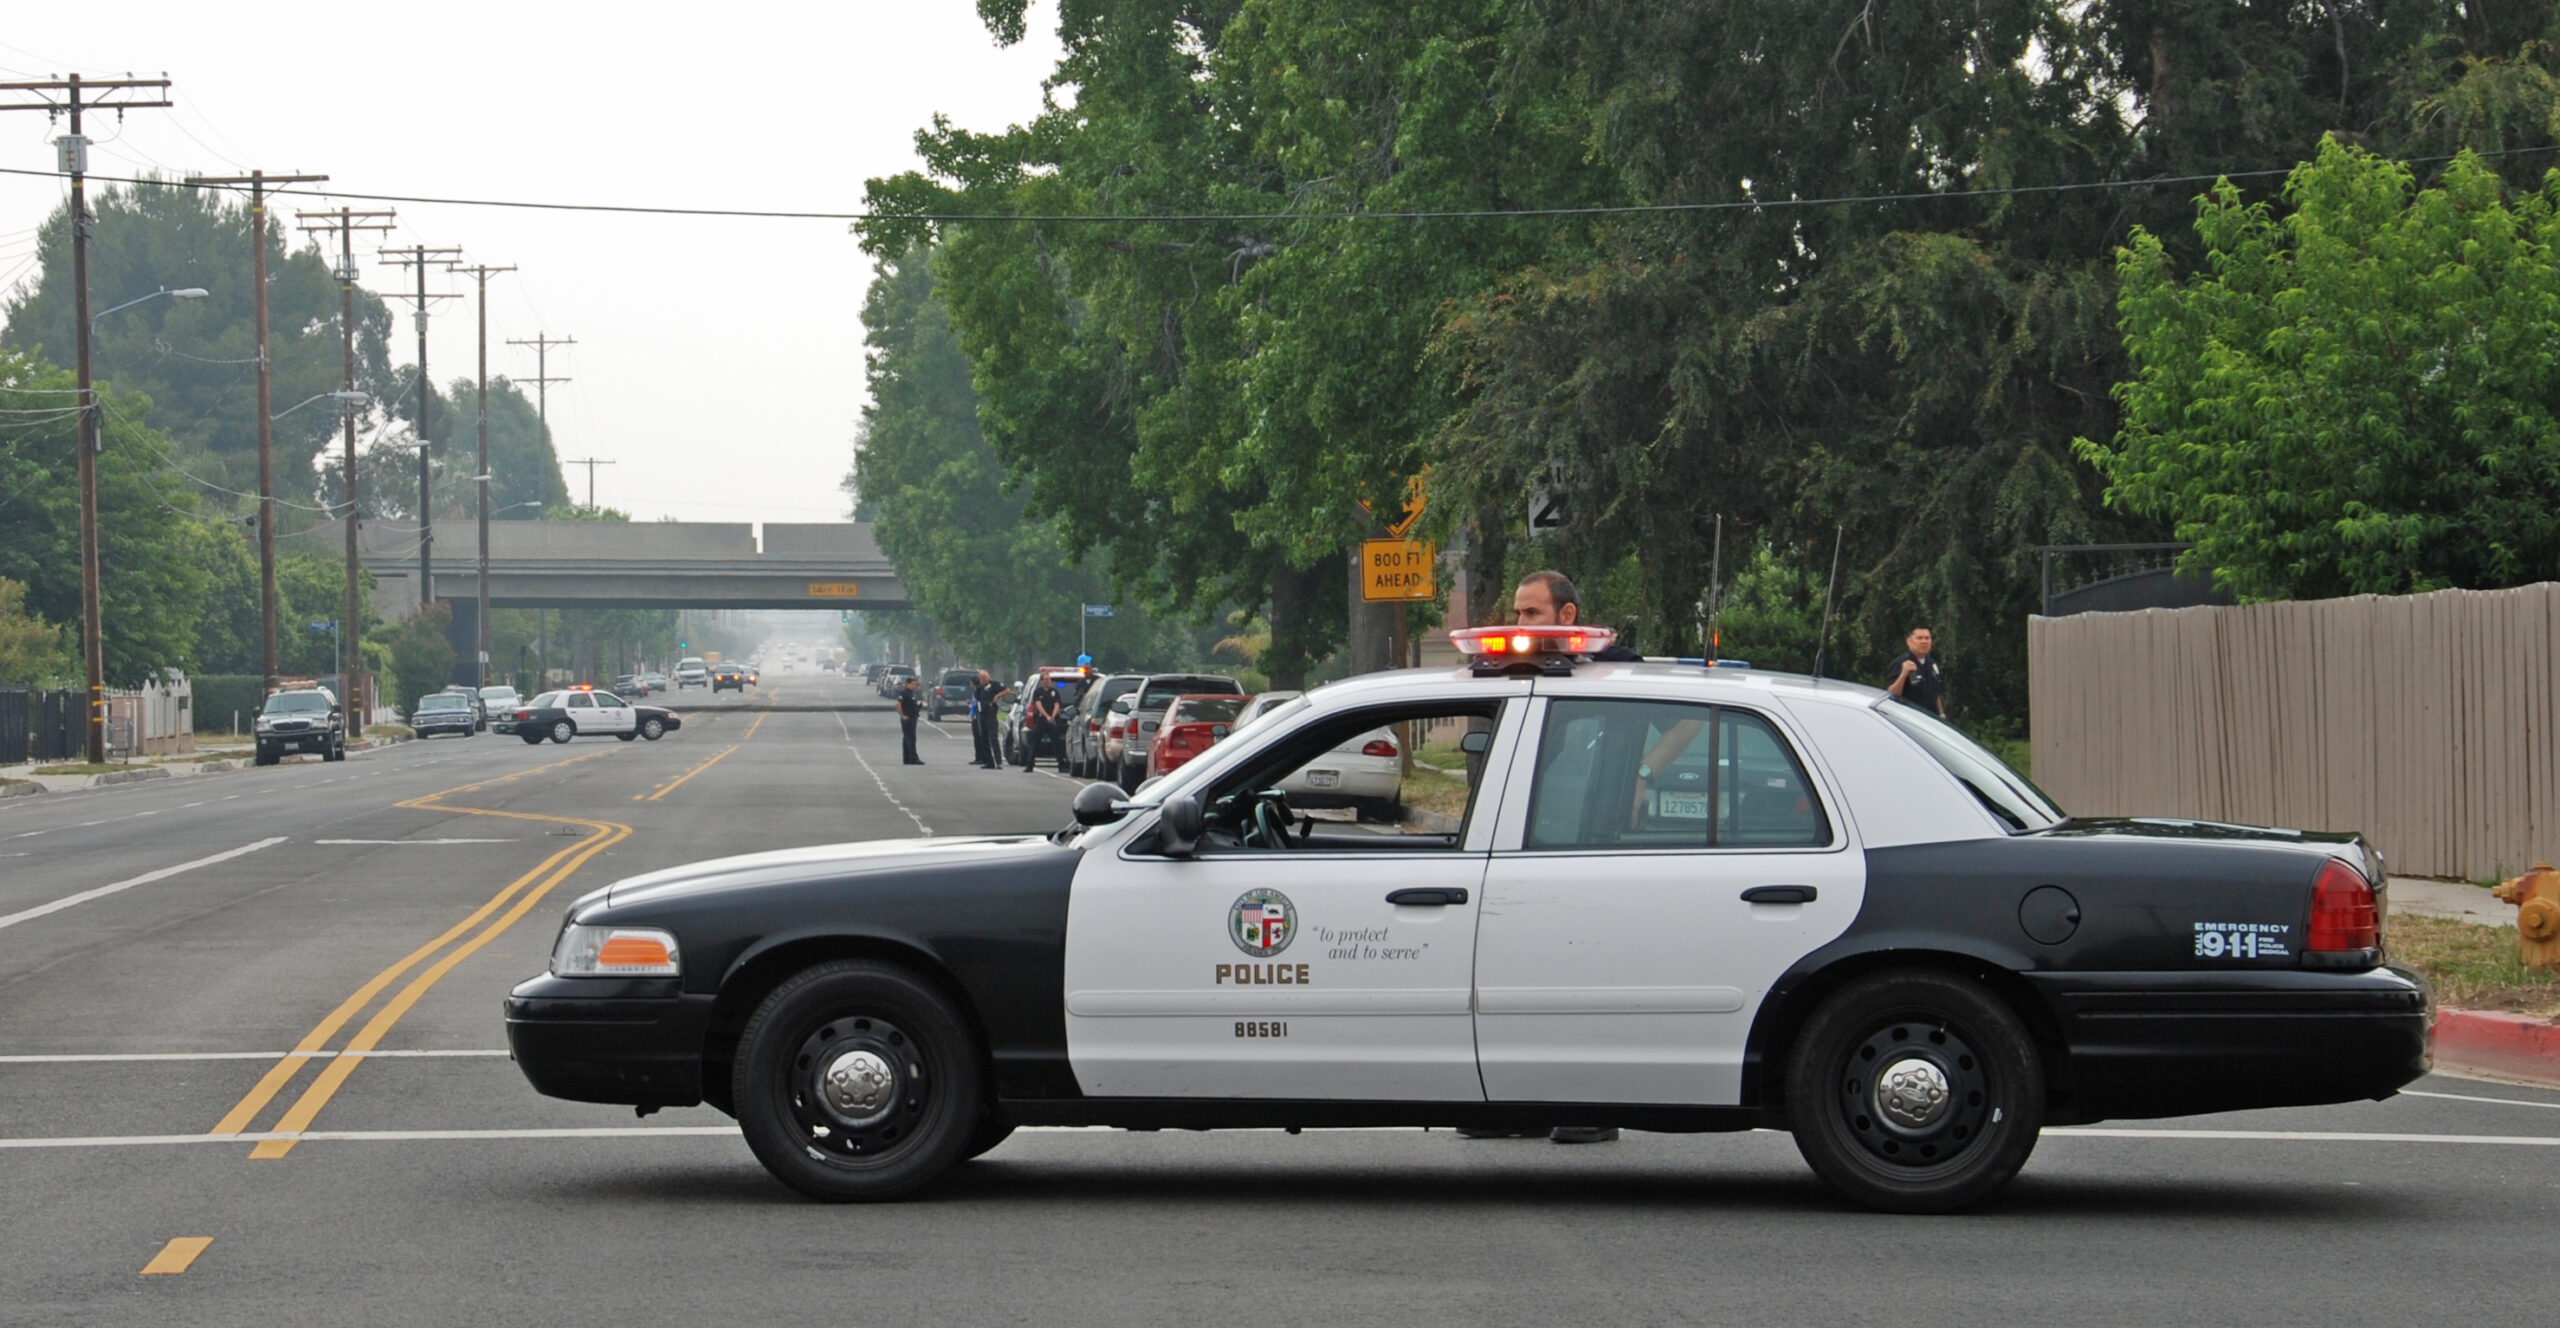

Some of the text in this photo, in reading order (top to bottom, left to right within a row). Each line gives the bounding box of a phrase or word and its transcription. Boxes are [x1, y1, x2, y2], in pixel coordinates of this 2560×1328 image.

[1374, 552, 1420, 567] 800 FT
[1375, 573, 1420, 588] AHEAD
[1338, 926, 1389, 945] protect
[2194, 922, 2289, 933] EMERGENCY
[1328, 943, 1359, 960] and
[1363, 945, 1377, 960] to
[2194, 932, 2204, 956] CALL
[1216, 964, 1309, 984] POLICE
[1234, 1021, 1288, 1038] 88581
